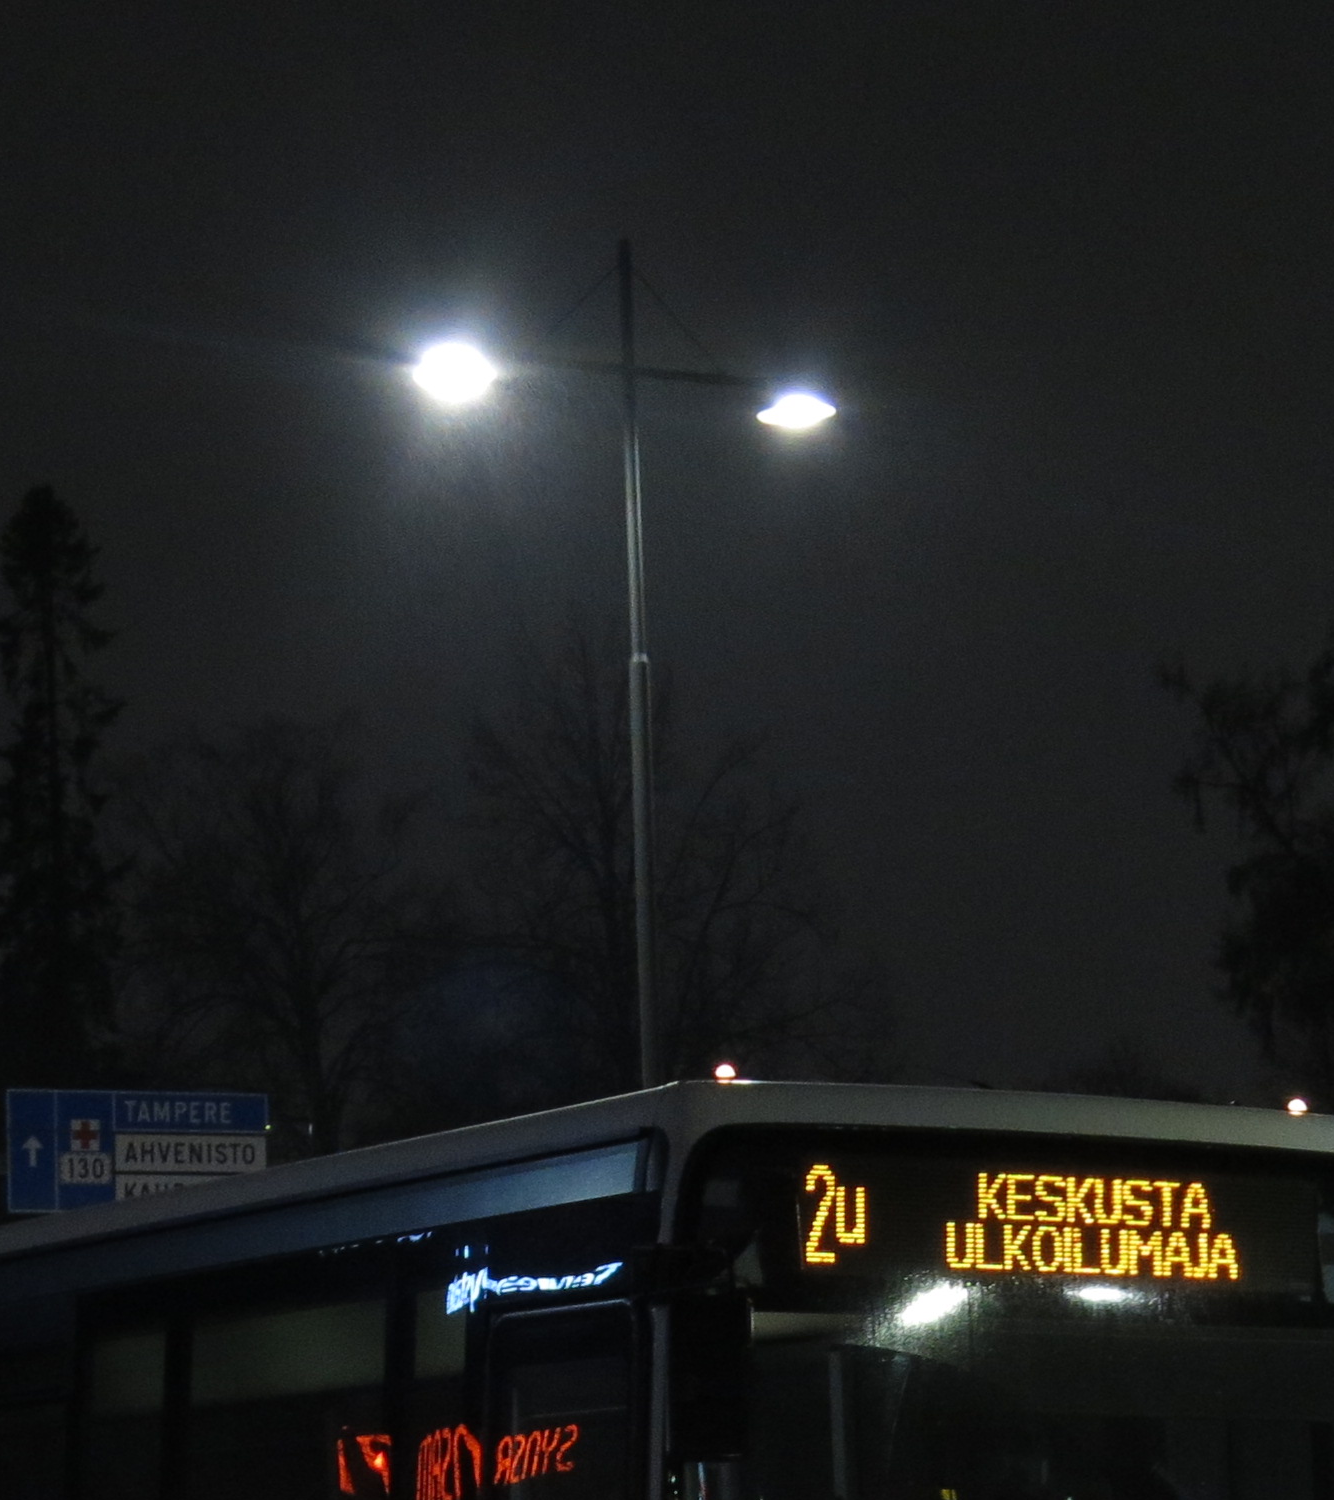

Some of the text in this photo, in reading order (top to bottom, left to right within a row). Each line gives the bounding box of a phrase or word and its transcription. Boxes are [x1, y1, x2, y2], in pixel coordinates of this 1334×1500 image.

[124, 1099, 233, 1124] TAMPERE
[124, 1142, 256, 1166] AHVENISTO
[67, 1157, 105, 1179] 130
[977, 1172, 1211, 1228] KESKUSTA
[945, 1221, 1239, 1279] ULKOILUMAJA
